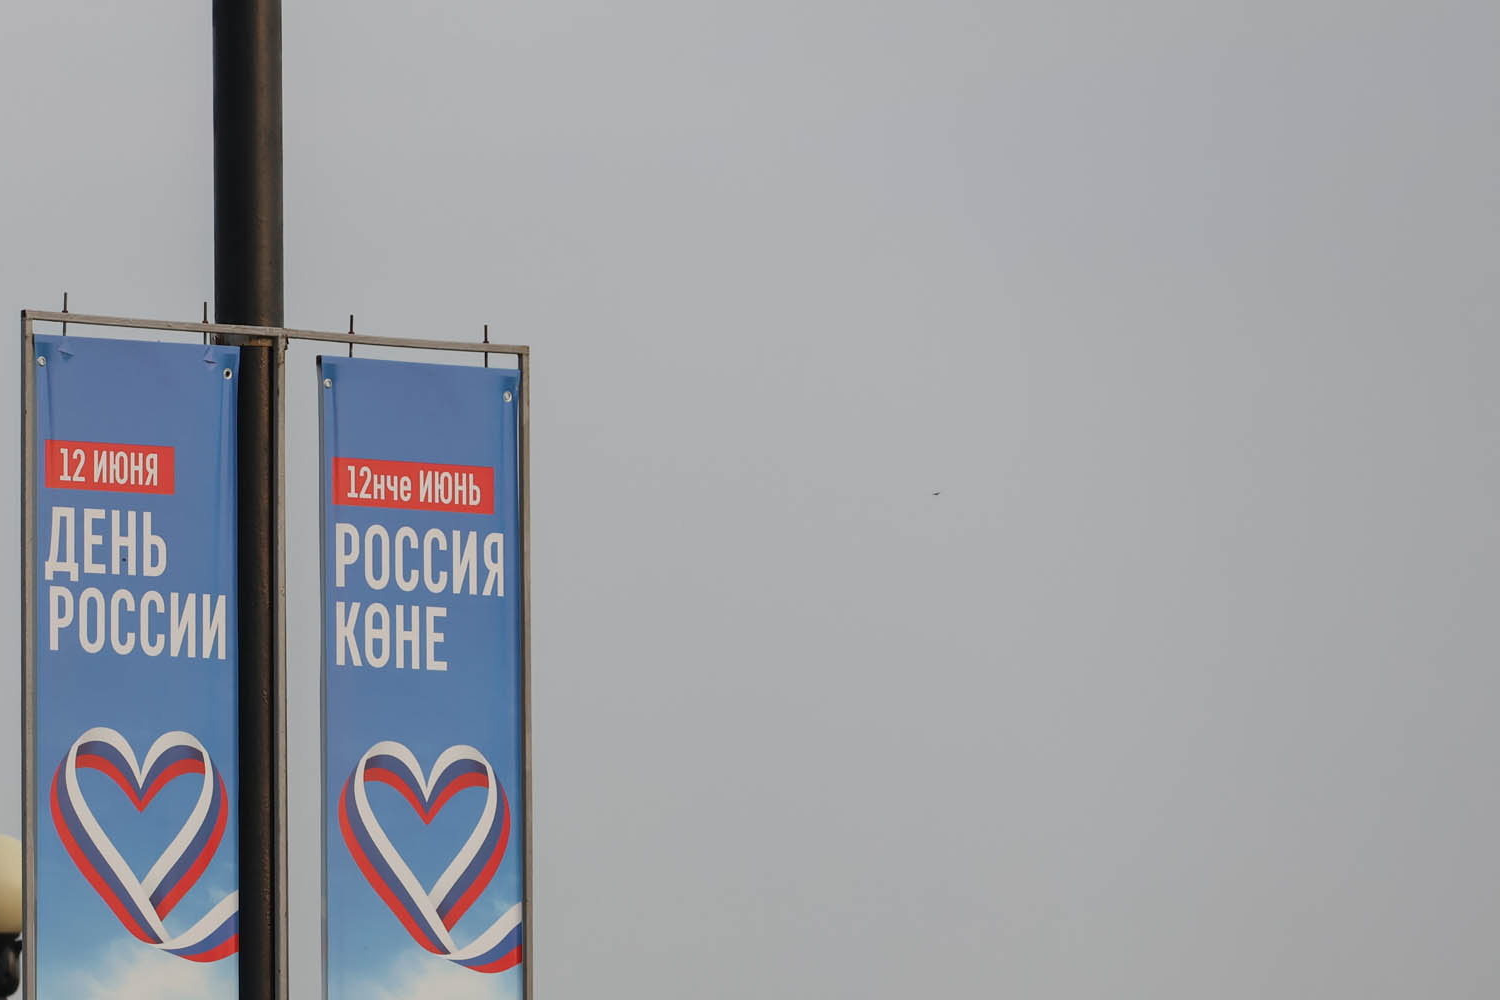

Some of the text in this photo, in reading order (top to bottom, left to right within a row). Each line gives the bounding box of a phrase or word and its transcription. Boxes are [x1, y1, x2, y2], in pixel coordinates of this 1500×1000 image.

[59, 447, 158, 486] 12 ИЮНЯ
[347, 465, 481, 506] 12нче ИЮНЬ
[44, 506, 167, 582] ДЕНЬ
[335, 522, 505, 597] РОССИЯ
[49, 585, 227, 660] РОССИИ
[335, 600, 448, 672] КӨНЕ
